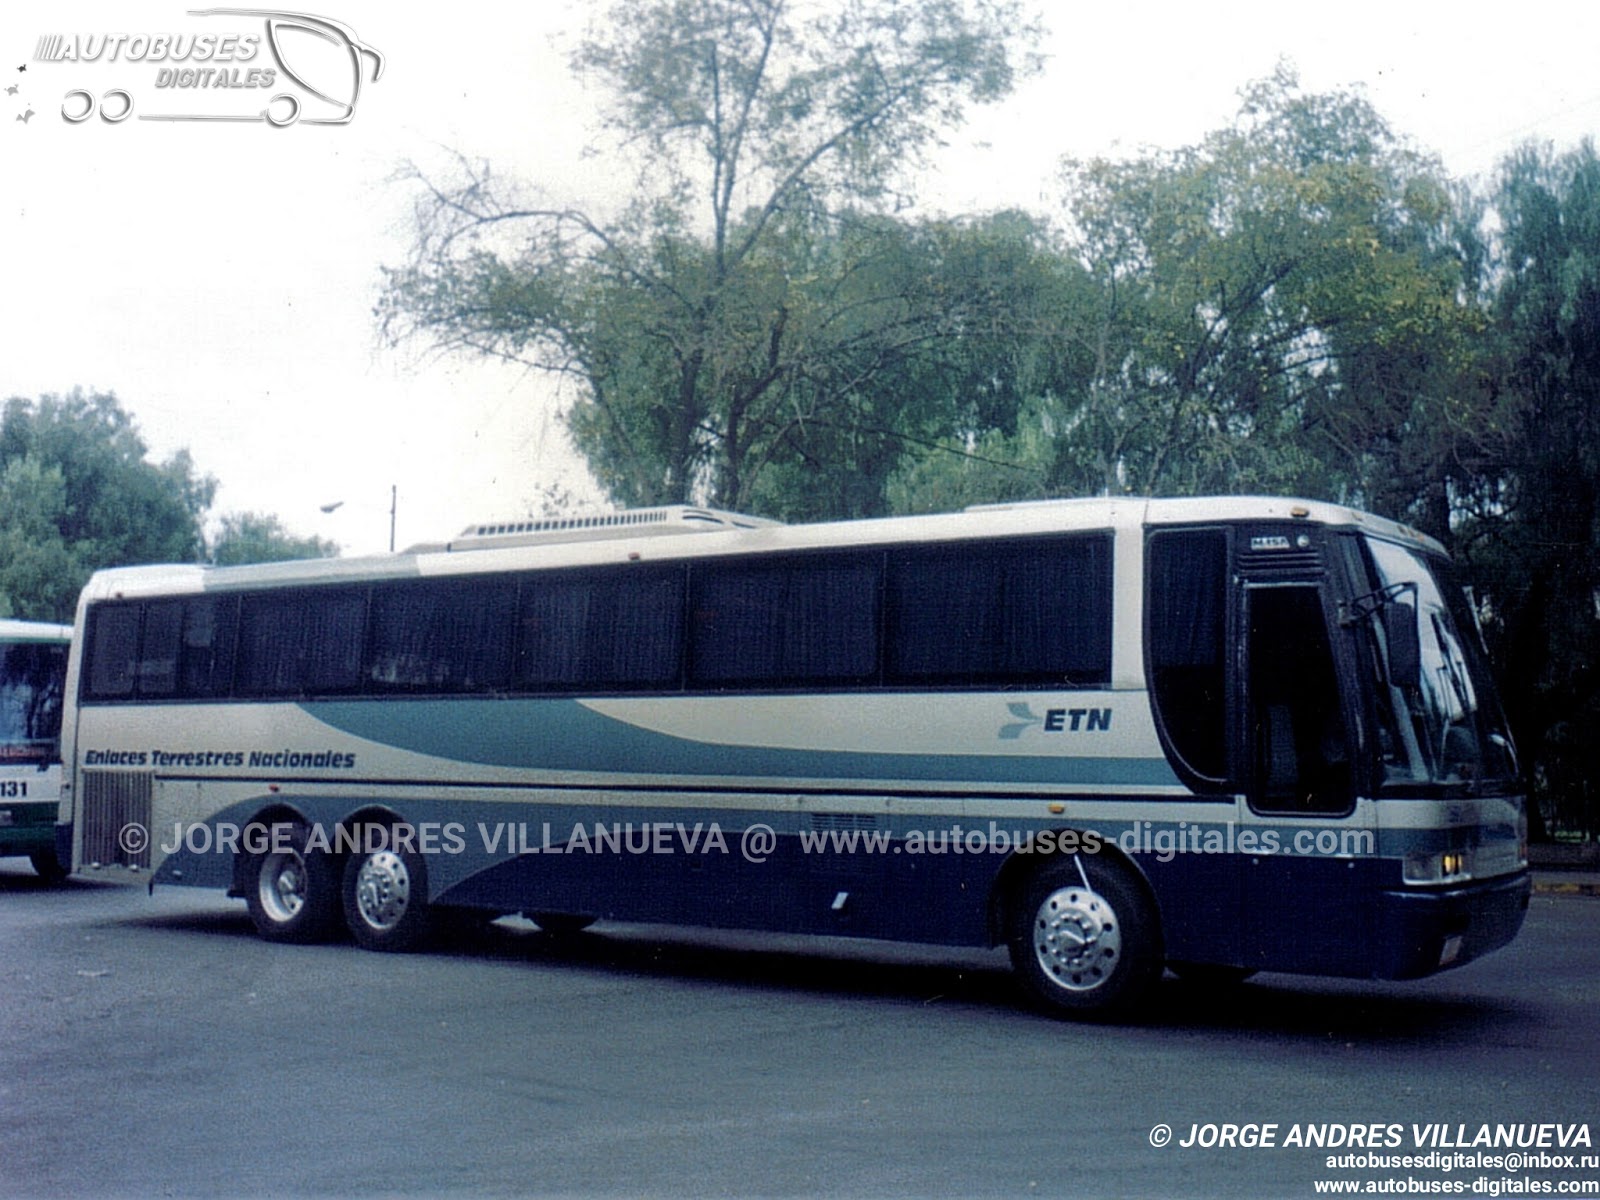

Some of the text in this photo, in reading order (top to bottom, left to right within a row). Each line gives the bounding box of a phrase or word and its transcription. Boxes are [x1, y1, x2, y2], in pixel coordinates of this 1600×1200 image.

[1044, 708, 1113, 732] ETN
[84, 749, 356, 769] Enlaces Terrestres Nacionales
